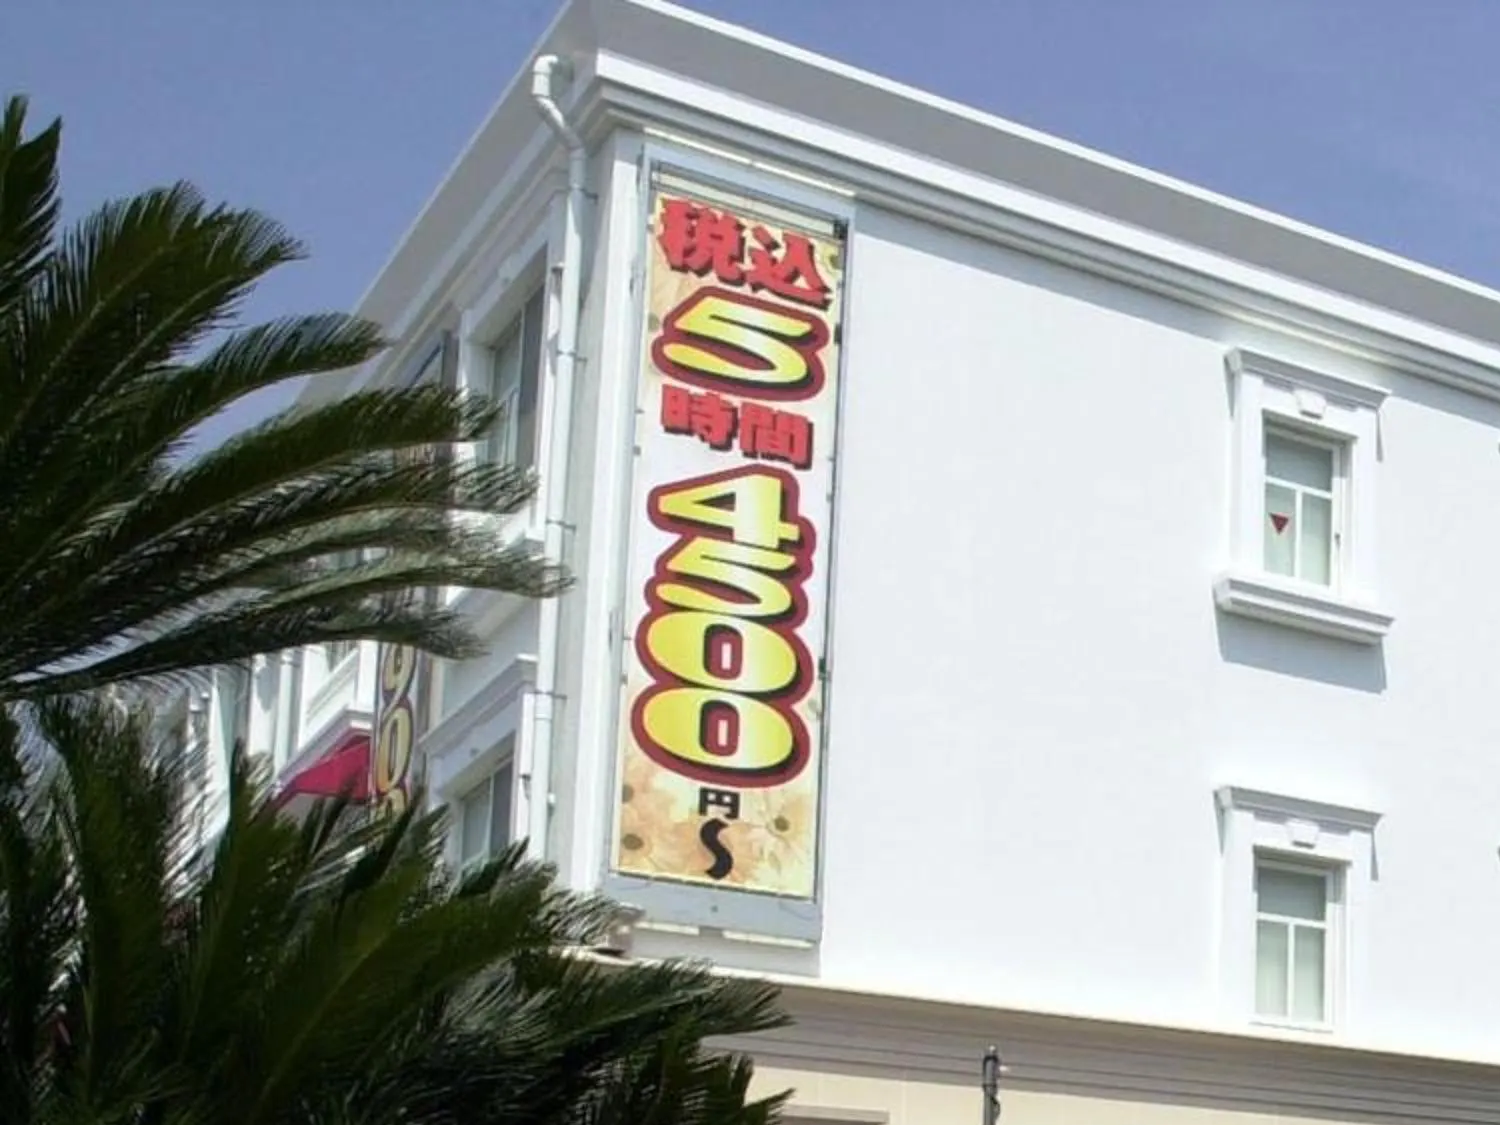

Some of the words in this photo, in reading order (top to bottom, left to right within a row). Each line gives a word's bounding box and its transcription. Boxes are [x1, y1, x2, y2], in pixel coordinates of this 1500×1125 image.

[659, 198, 832, 311] 税込
[652, 287, 829, 400] 5
[661, 383, 814, 470] 時間
